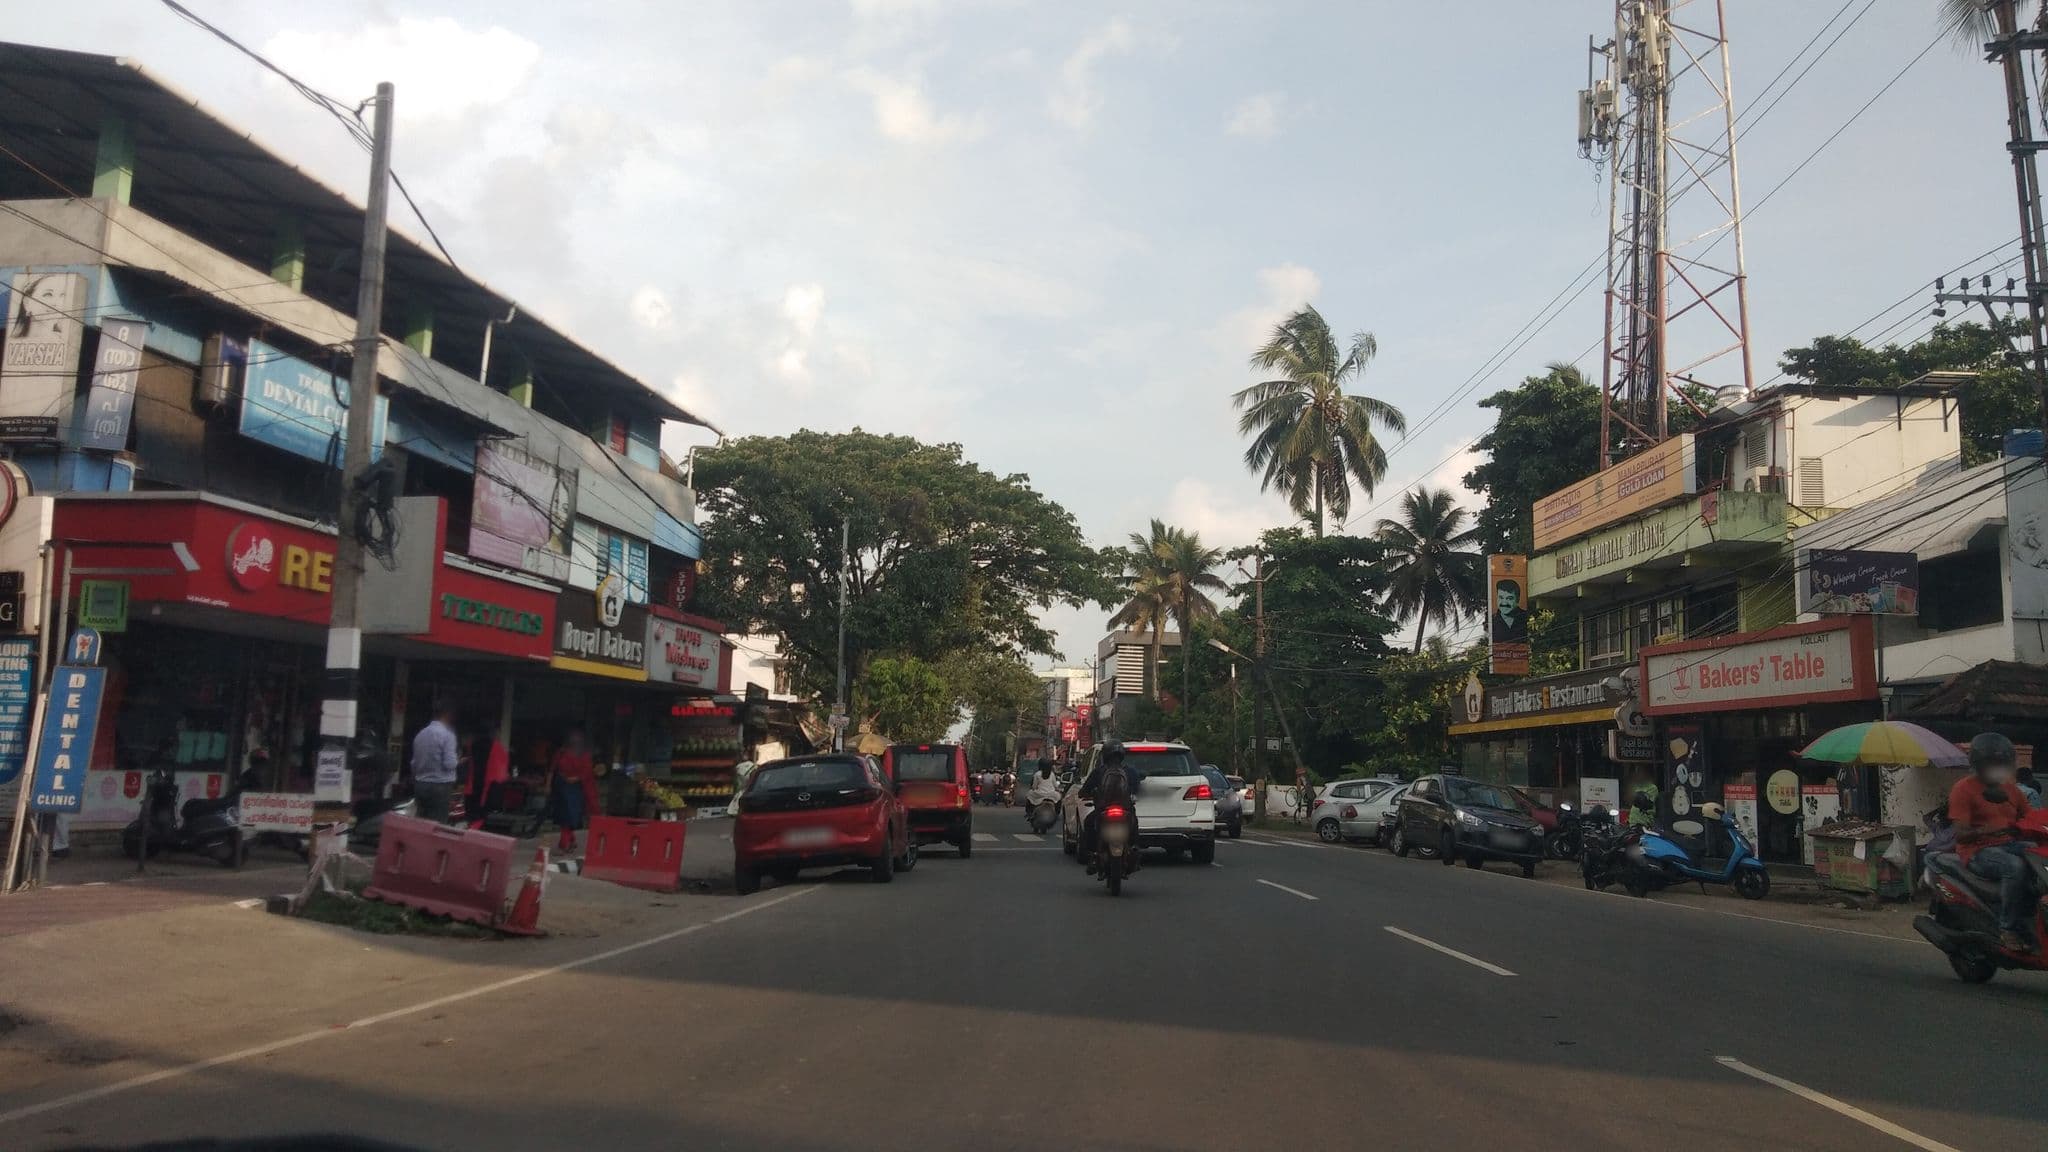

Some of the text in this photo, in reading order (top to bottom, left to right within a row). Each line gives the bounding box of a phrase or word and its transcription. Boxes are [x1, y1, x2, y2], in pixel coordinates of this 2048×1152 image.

[7, 343, 65, 366] VARSHA
[263, 379, 318, 417] DENTAL
[1620, 478, 1641, 497] GOLD
[1642, 467, 1665, 488] LOAN
[282, 544, 334, 593] RE
[562, 620, 643, 663] Royal Bakers
[1700, 651, 1825, 690] Bakers' Table
[53, 673, 87, 790] DENTAL
[37, 794, 77, 806] CLINIC
